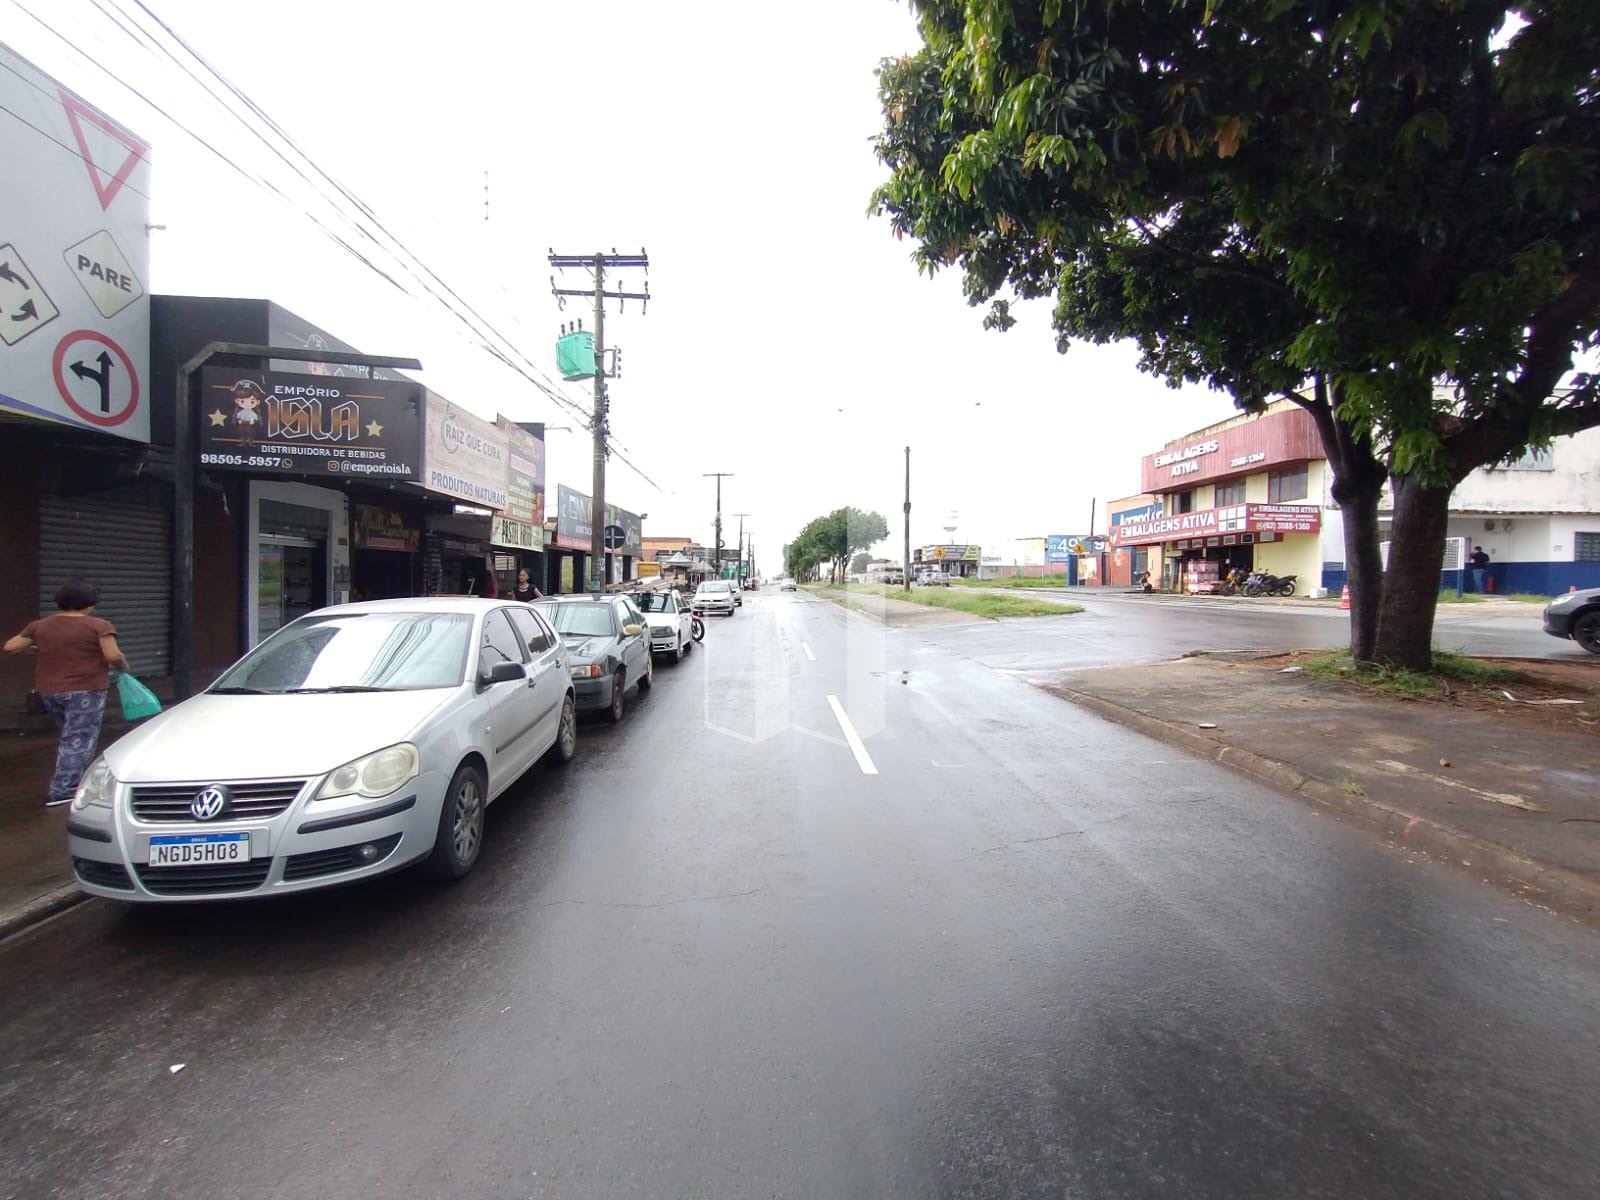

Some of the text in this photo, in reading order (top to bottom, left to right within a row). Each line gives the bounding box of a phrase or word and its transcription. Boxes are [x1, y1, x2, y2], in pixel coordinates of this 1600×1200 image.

[77, 254, 132, 293] PARE
[275, 385, 340, 397] EMPÓRIO
[265, 395, 360, 441] ISLA
[261, 445, 386, 460] DISTRIBUIDORA DE BEBIDAS
[445, 424, 464, 444] RAIZ
[466, 435, 482, 452] QUE
[483, 443, 501, 463] CURA
[1154, 439, 1219, 468] EMBALAGENS
[201, 453, 281, 467] 98505-5957
[341, 460, 411, 475] @emporioisla
[1171, 460, 1199, 477] ATIVA
[431, 471, 473, 496] PRODUTOS
[475, 486, 506, 506] NATURAIS
[1120, 519, 1180, 538] EMBALAGENS
[1182, 511, 1215, 529] ATIVA
[158, 843, 238, 863] NGD5H08
